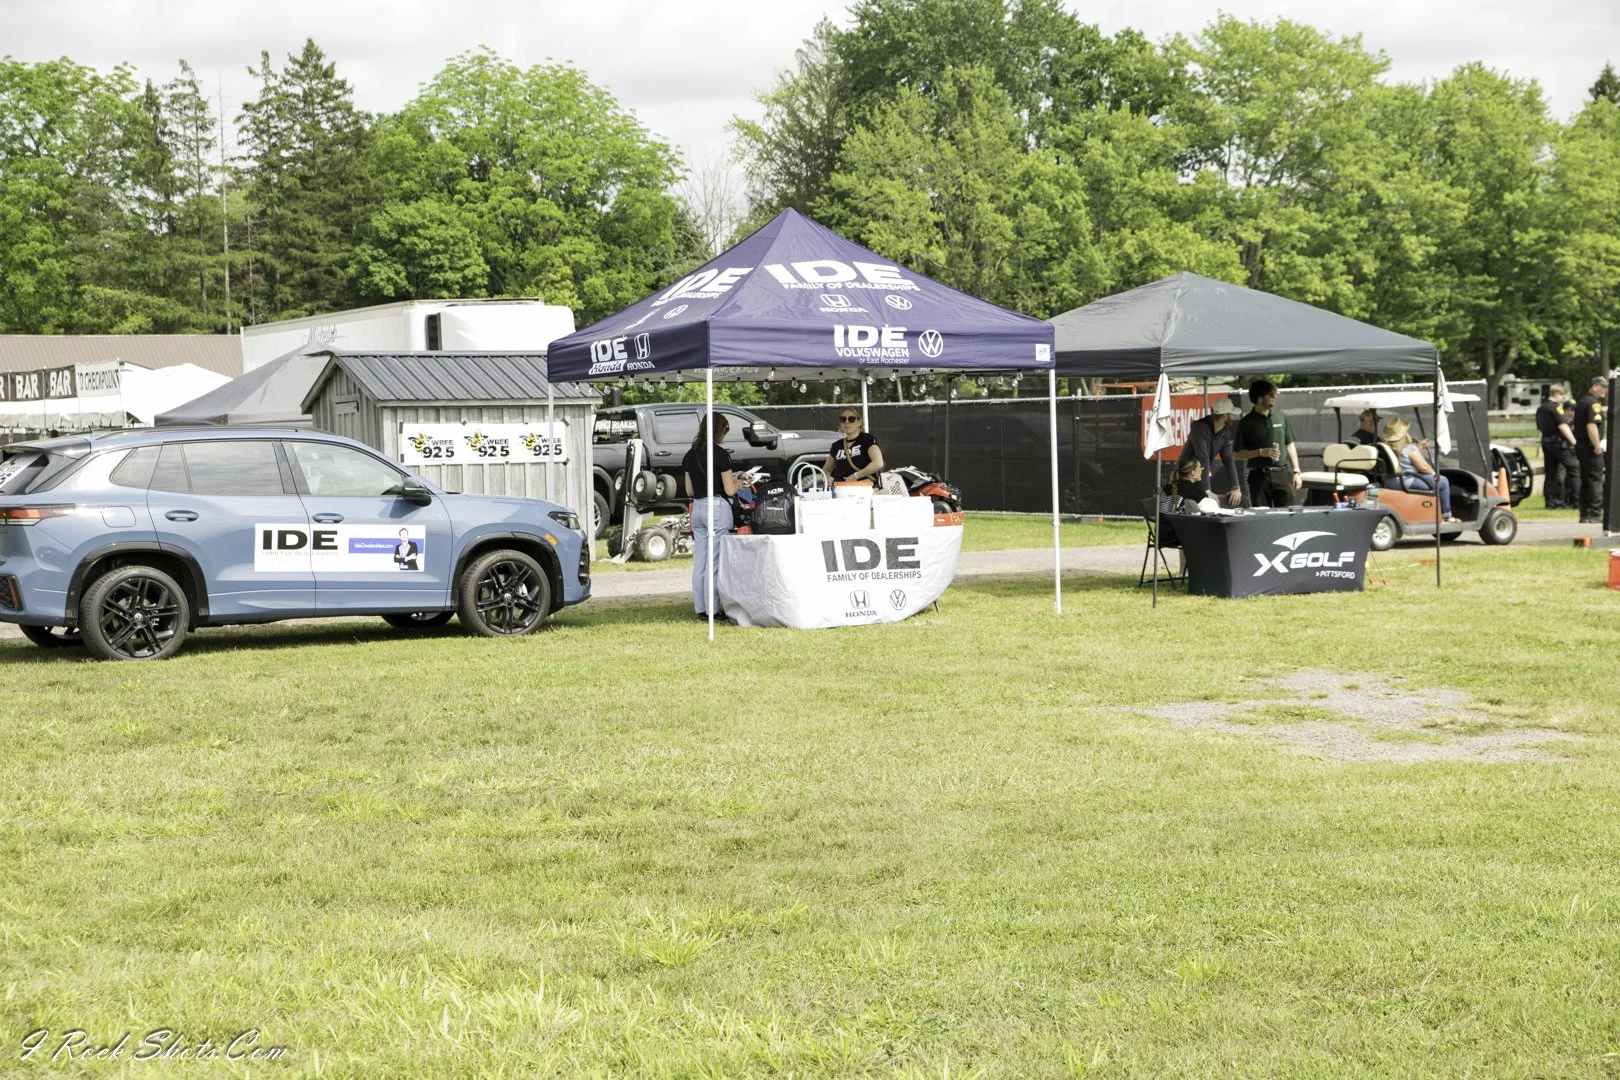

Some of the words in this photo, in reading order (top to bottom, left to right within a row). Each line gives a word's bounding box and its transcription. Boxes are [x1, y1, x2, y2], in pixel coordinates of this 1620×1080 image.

[764, 260, 915, 286] IDE
[659, 267, 754, 301] IDE
[782, 282, 823, 290] FAMILY
[827, 282, 843, 290] OF
[844, 282, 921, 292] DEALERSHIPS
[833, 325, 908, 348] IDE
[590, 336, 629, 363] IDE
[835, 347, 910, 358] VOLKSWAGEN
[591, 361, 622, 374] Honda
[627, 361, 656, 371] HONDA
[867, 356, 880, 364] East
[881, 356, 910, 364] Rochester
[15, 374, 39, 399] BAR
[49, 370, 71, 397] BAR
[262, 529, 338, 550] IDE
[821, 537, 921, 573] IDE
[827, 572, 857, 582] FAMILY
[858, 572, 869, 581] OF
[871, 570, 922, 580] DEALERSHIPS
[1320, 570, 1356, 579] PITTSFORD
[845, 610, 878, 618] HONDA
